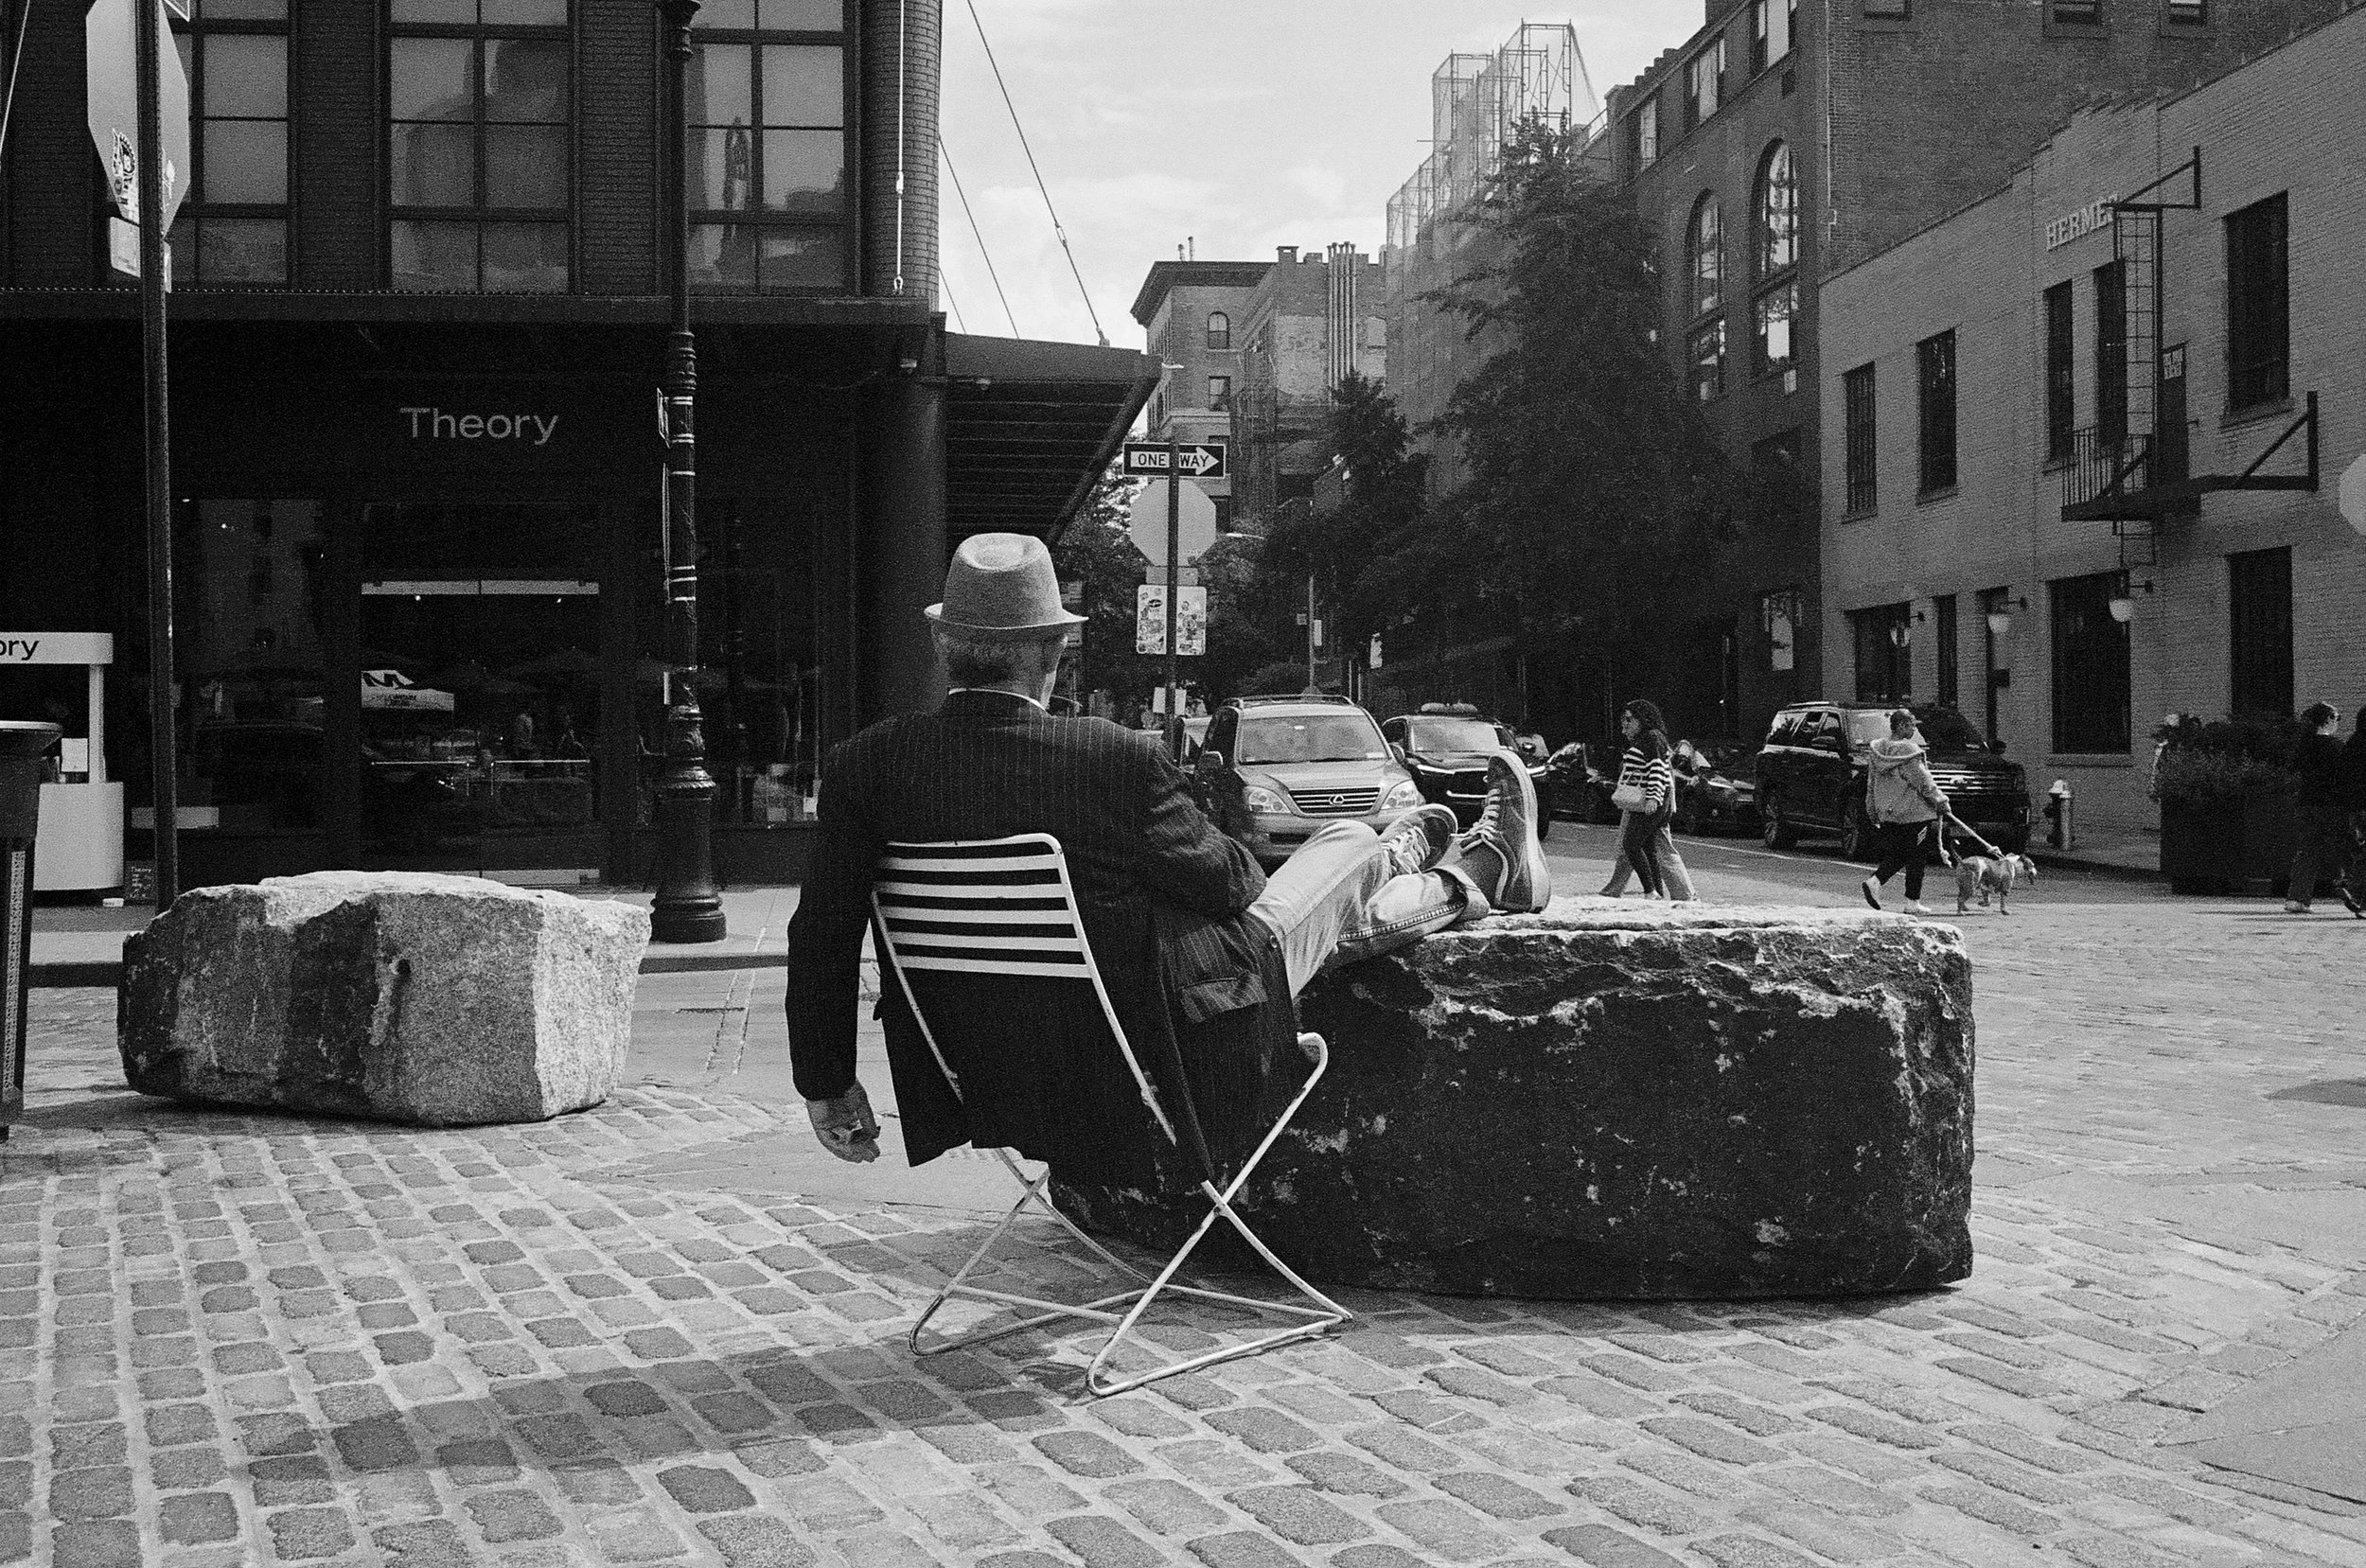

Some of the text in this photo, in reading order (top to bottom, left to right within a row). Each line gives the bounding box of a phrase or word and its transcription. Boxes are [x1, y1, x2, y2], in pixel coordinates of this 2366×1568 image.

[399, 407, 559, 446] Theory
[1138, 453, 1209, 467] ONE WAY
